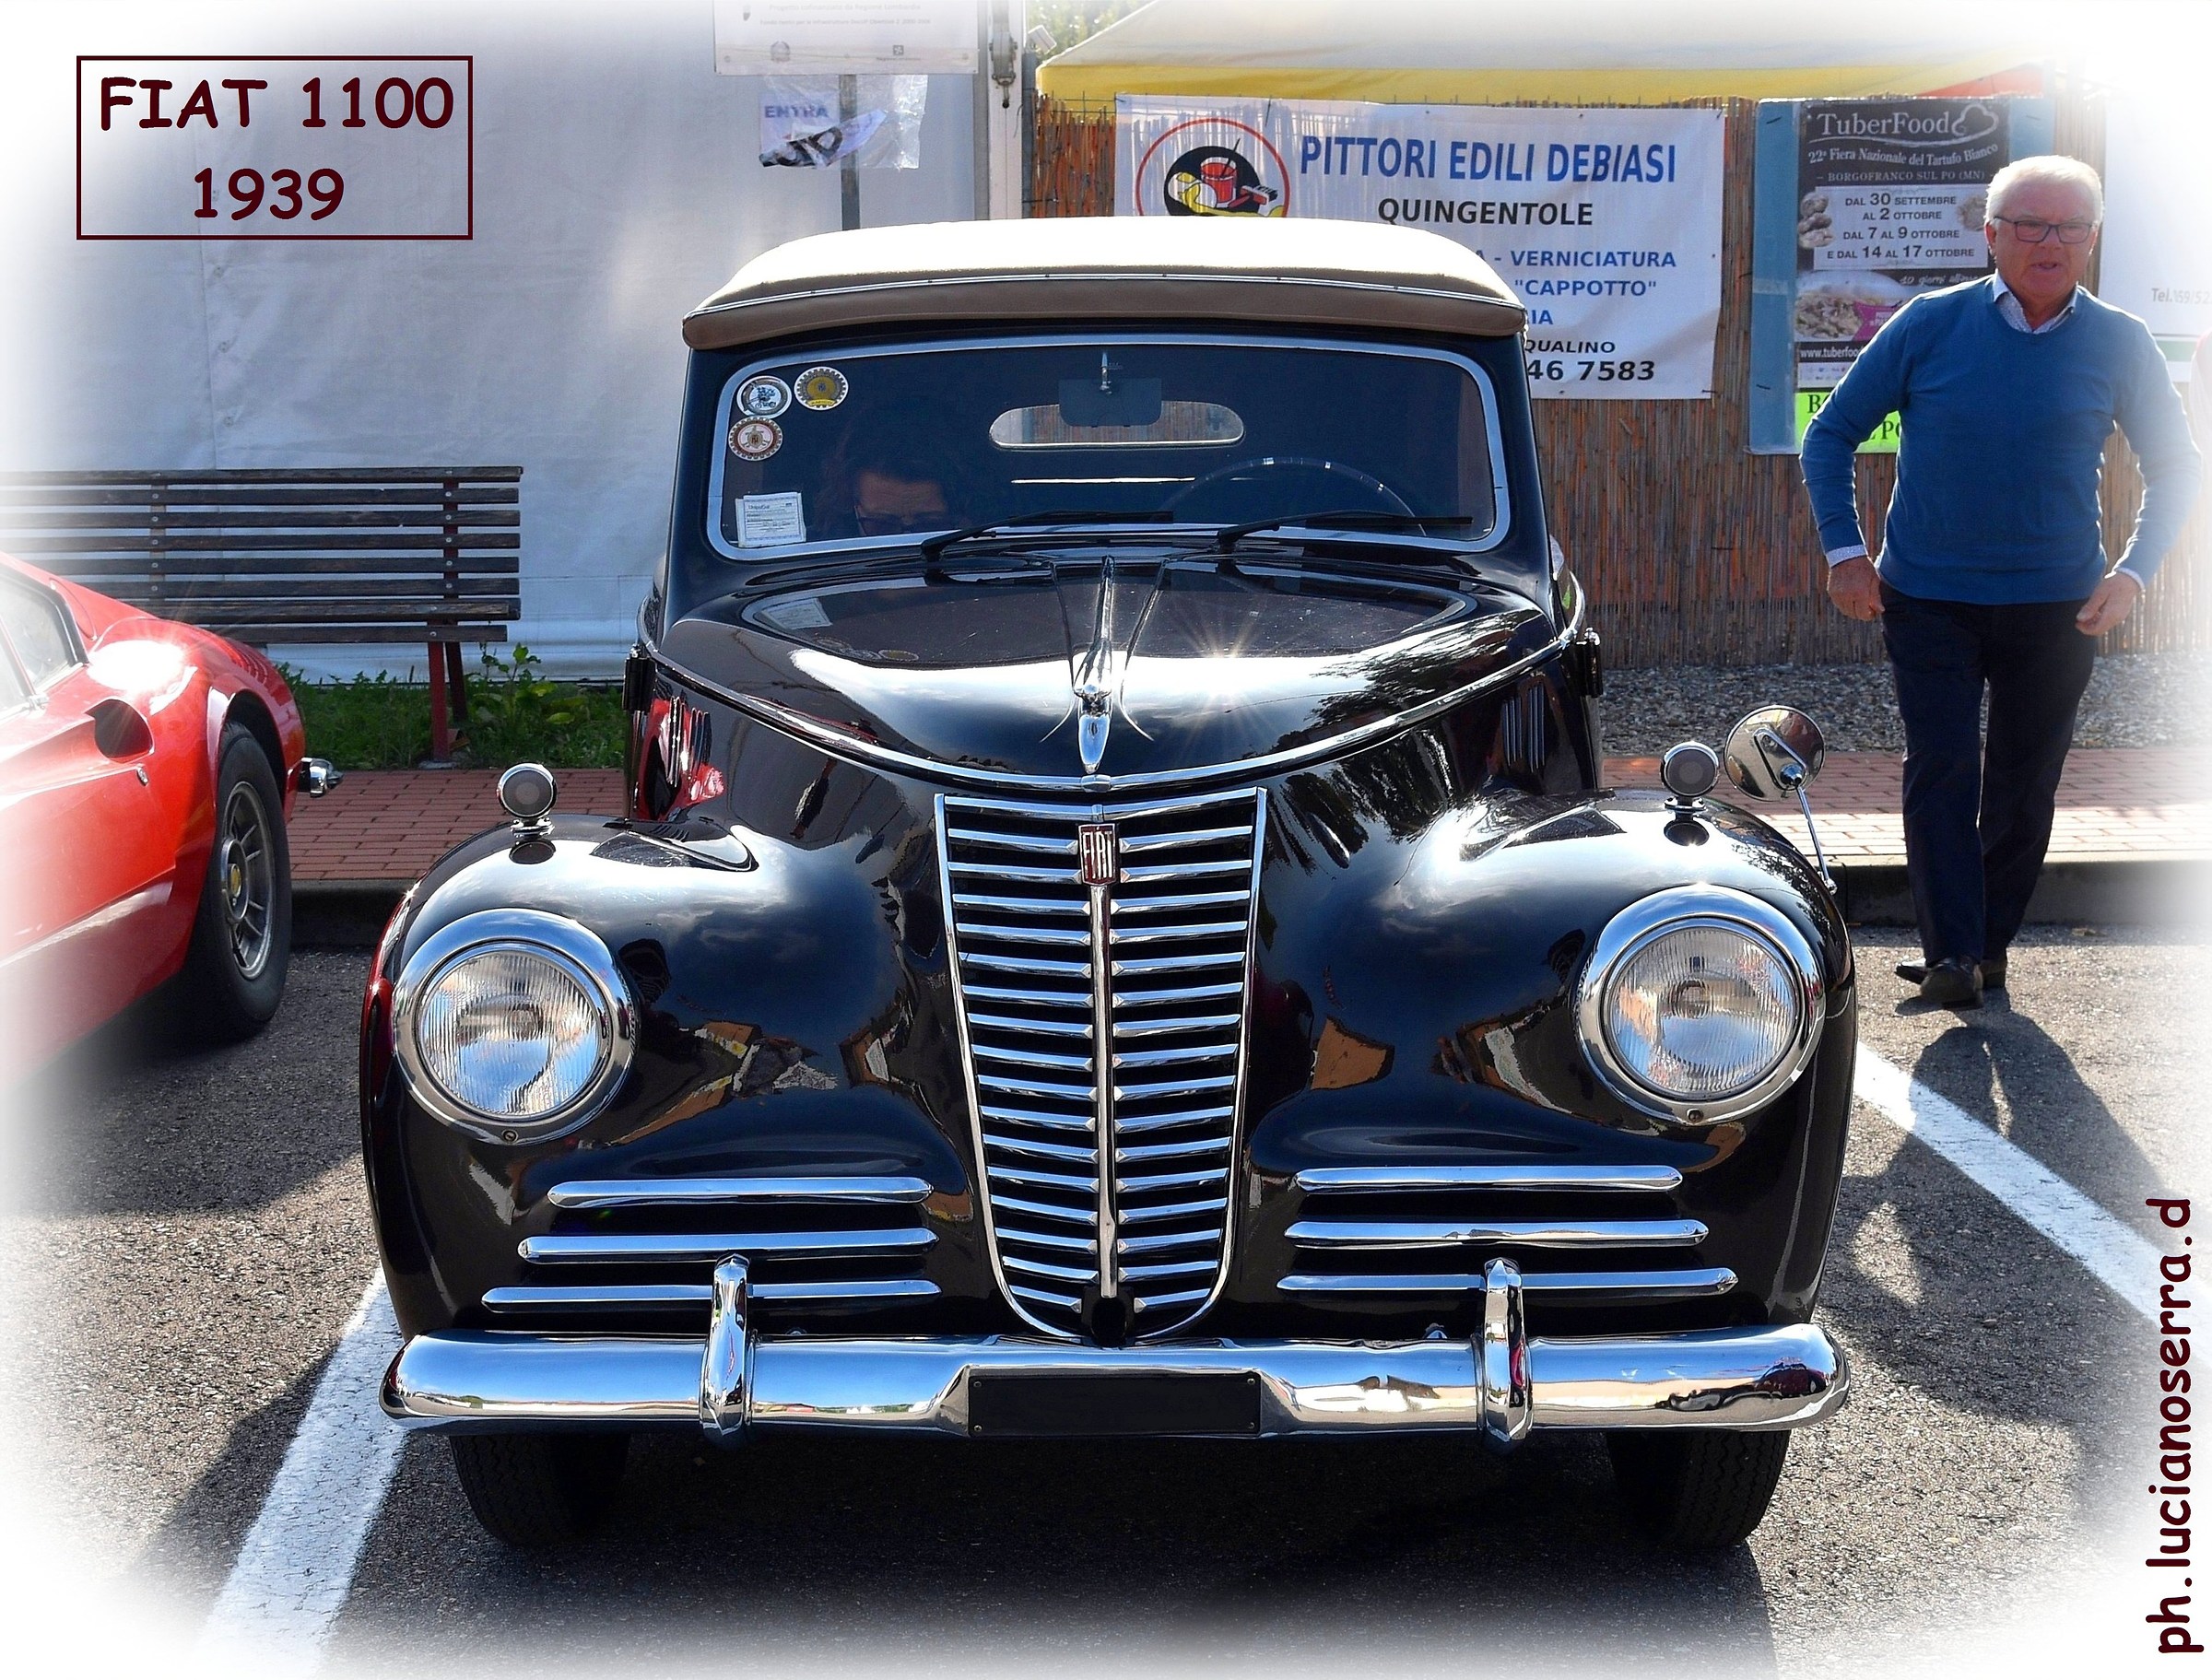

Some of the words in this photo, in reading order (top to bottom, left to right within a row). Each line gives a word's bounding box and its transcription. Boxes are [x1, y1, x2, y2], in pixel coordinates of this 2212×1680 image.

[1816, 111, 1950, 135] TuberFood
[1300, 135, 1436, 179] PITTORI
[1449, 141, 1535, 182] EDILI
[1547, 144, 1676, 183] DEBIASI
[1830, 147, 1855, 160] Fiera
[1858, 147, 1907, 164] Nazionale
[1909, 152, 1924, 166] del
[1926, 151, 1961, 166] Tartufo
[1964, 143, 1999, 162] Bianco
[1828, 170, 1913, 182] BORGOFRANCO
[1917, 170, 1936, 181] SUL
[1941, 170, 1956, 181] PO
[1845, 197, 1865, 206] DAL
[1869, 193, 1891, 206] 30
[1894, 195, 1957, 206] SETTEMBRE
[1377, 197, 1594, 227] QUINGENTOLE
[1863, 212, 1877, 221] AL
[1879, 207, 1890, 221] 2
[1893, 211, 1942, 221] OTTOBRE
[1843, 231, 1865, 241] DAL
[1868, 227, 1878, 240] 7
[1880, 230, 1894, 240] AL
[1898, 227, 1908, 240] 9
[1911, 229, 1960, 240] OTTOBRE
[1511, 250, 1677, 267] VERNICIATURA
[1827, 251, 1834, 259] E
[1837, 250, 1858, 259] DAL
[1862, 245, 1882, 258] 14
[1885, 249, 1899, 258] AL
[1902, 245, 1923, 258] 17
[1925, 248, 1975, 258] OTTOBRE
[1514, 279, 1657, 296] "CAPPOTTO"
[2151, 288, 2173, 302] Tel.
[1528, 309, 1554, 325] IA
[1524, 338, 1617, 355] QUALINO
[1800, 346, 1864, 358] www.tuberfoo
[1577, 359, 1655, 382] 7583
[1082, 830, 1113, 879] FIAT
